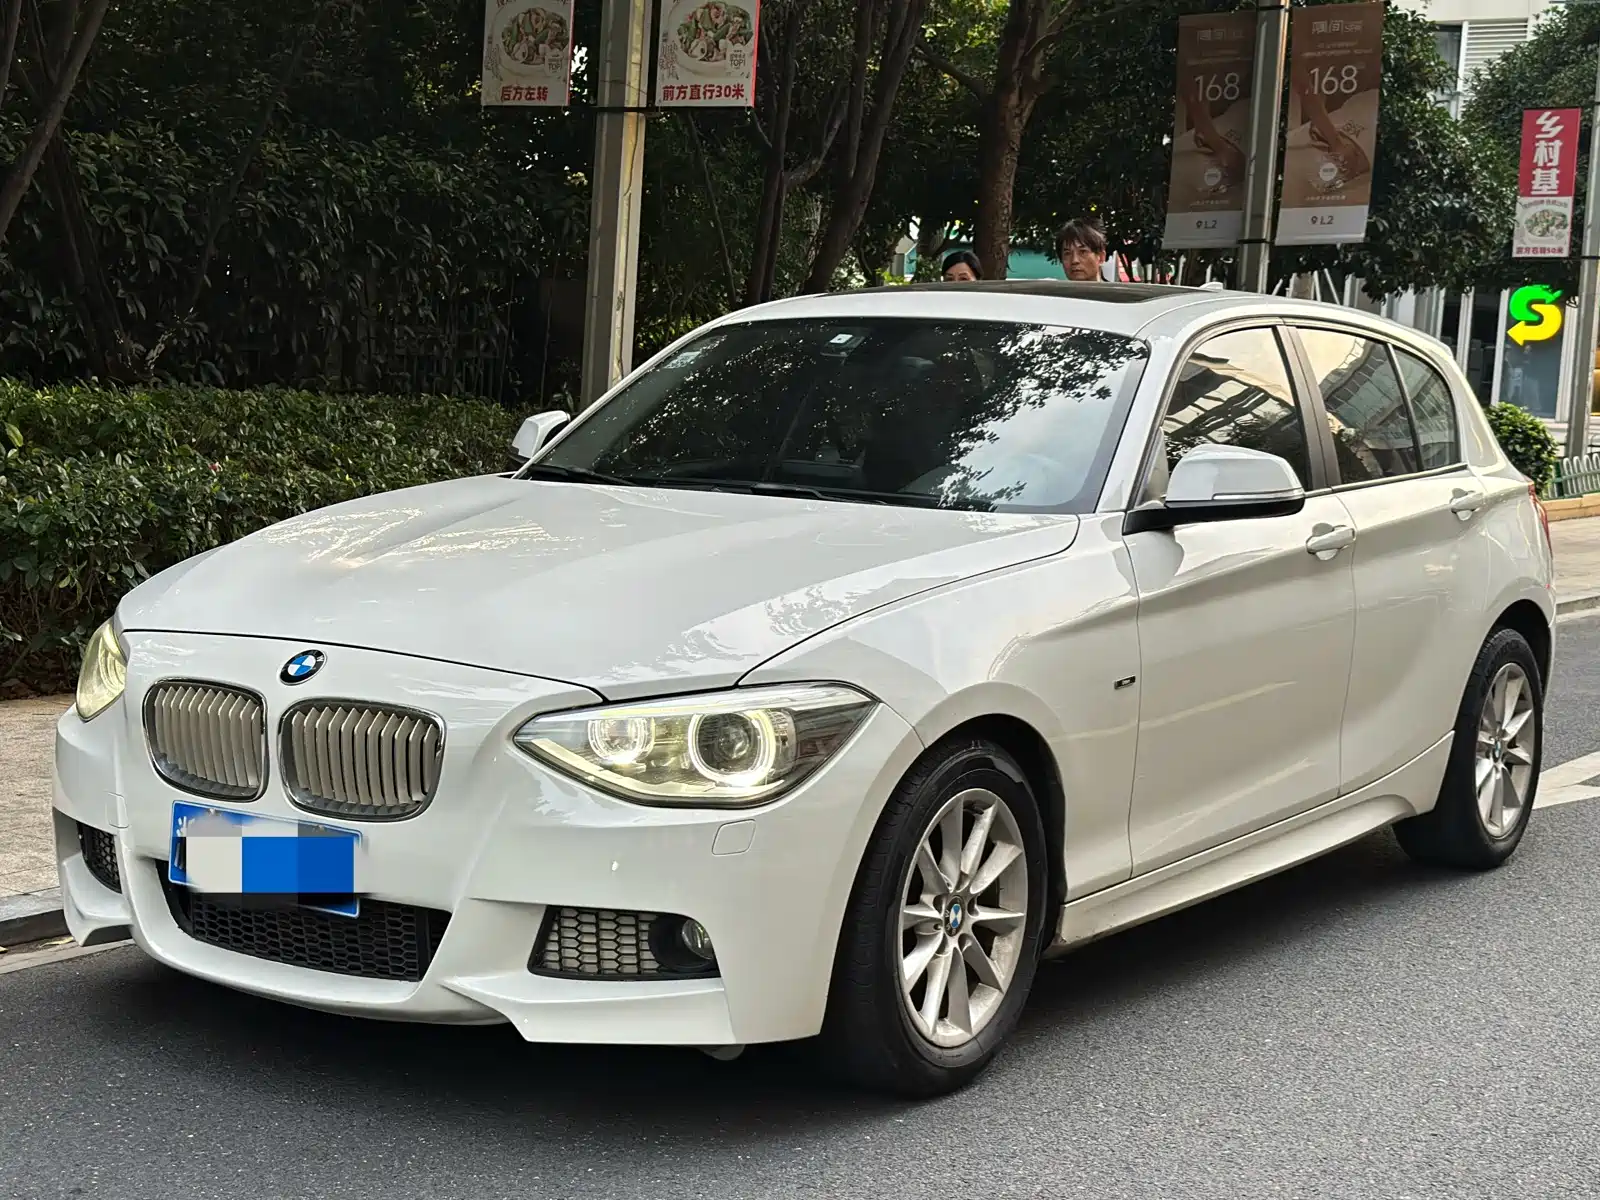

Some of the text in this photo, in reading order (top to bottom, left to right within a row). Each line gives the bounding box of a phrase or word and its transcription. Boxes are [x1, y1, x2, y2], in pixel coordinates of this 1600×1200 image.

[1194, 72, 1240, 101] 168
[1309, 64, 1358, 95] 168
[501, 85, 548, 102] 后方左转
[662, 83, 744, 101] 前方直行30米
[1530, 111, 1564, 195] 乡村基
[1320, 215, 1334, 225] L2
